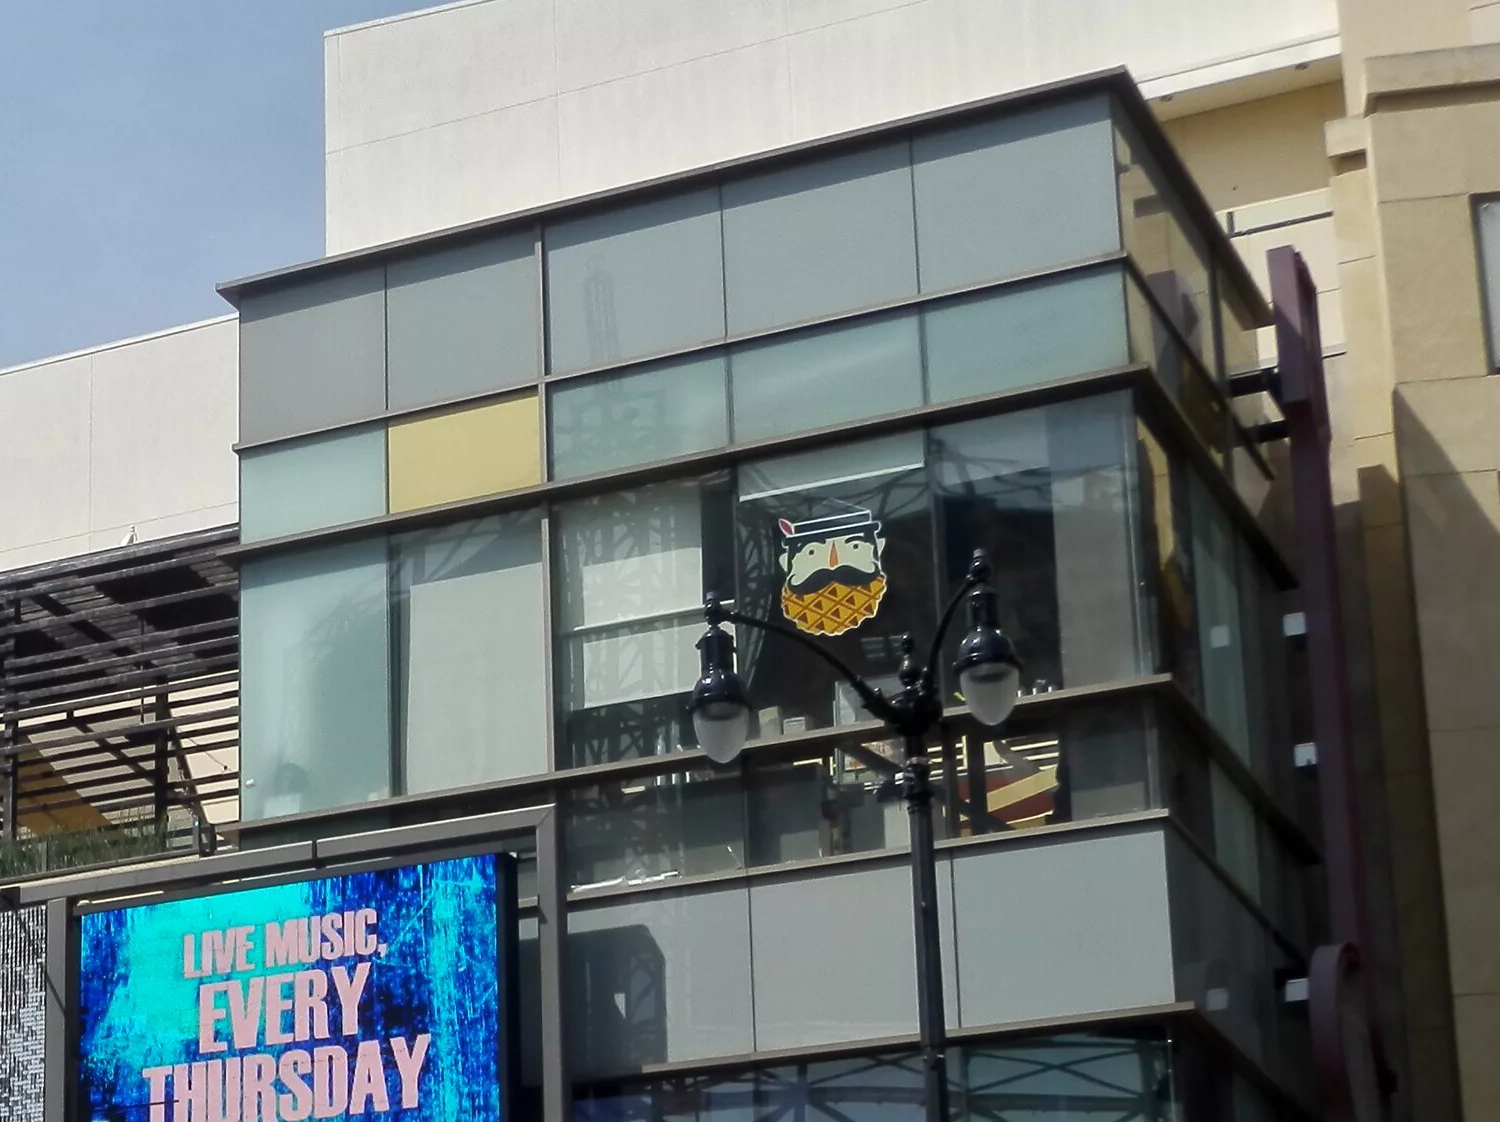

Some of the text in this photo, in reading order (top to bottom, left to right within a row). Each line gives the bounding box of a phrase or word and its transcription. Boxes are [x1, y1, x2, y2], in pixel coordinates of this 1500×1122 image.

[183, 908, 387, 978] LIVE MUSIC,
[199, 962, 372, 1054] EVERY
